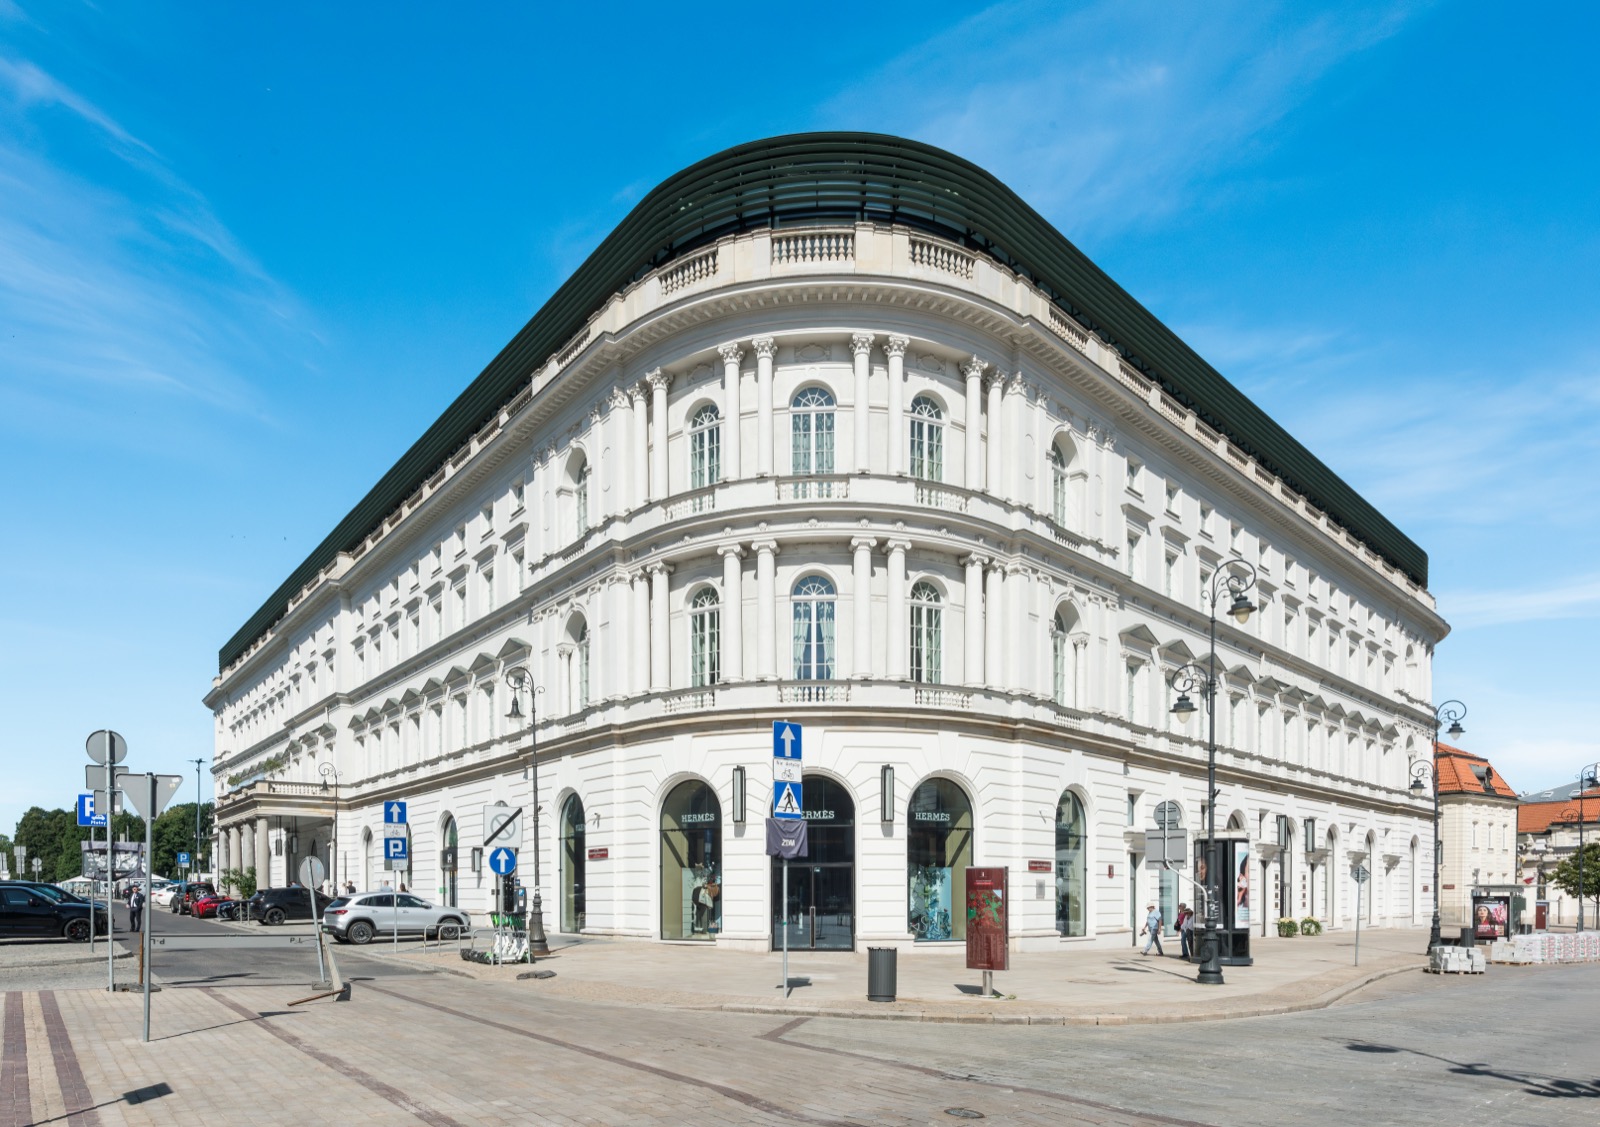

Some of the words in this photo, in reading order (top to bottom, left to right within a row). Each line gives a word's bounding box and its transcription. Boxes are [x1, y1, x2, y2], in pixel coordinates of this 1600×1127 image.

[681, 813, 715, 822] HERMÈS
[915, 811, 950, 821] HERMÈS
[389, 840, 403, 857] P
[180, 854, 187, 862] P
